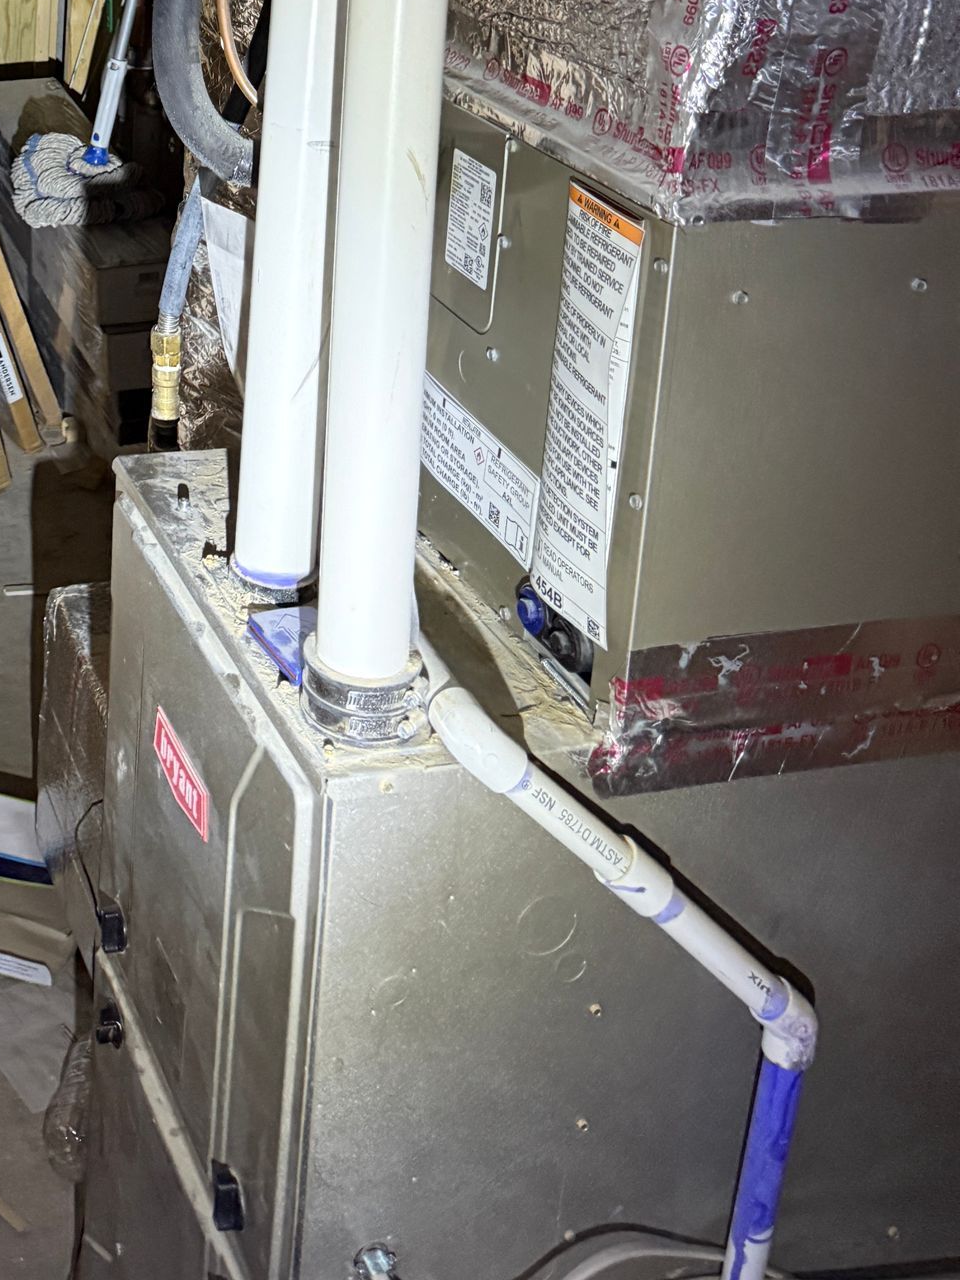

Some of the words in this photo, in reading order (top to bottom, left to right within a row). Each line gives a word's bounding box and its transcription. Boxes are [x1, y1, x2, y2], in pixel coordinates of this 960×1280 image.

[501, 70, 540, 101] Shurtape
[550, 96, 565, 111] AF
[565, 99, 584, 119] 099
[613, 121, 657, 159] Shurtape
[690, 155, 706, 170] AF
[579, 208, 590, 224] RISK
[590, 215, 597, 230] OF
[598, 221, 611, 240] FIRE
[583, 196, 611, 224] WARNING
[586, 243, 615, 273] REPAIRED
[590, 230, 633, 270] REFRIGERANT
[576, 250, 597, 277] TRAINED
[598, 268, 623, 296] SERVICE
[583, 272, 590, 286] DO
[591, 278, 603, 297] NOT
[577, 280, 613, 321] REFRIGERANT
[0, 359, 16, 396] ANDERSEN
[572, 366, 605, 407] REFRIGERANT
[437, 402, 474, 445] INSTALLATION
[565, 390, 584, 419] DEVICES
[585, 411, 603, 435] WHICH
[434, 423, 449, 447] ROOM
[450, 440, 465, 462] AREA
[571, 425, 600, 460] INSTALLED
[577, 417, 603, 449] SOURCES
[437, 451, 459, 482] CHARGE
[440, 443, 448, 459] OR
[582, 449, 602, 475] OTHER
[422, 446, 434, 470] TOTAL
[436, 462, 459, 494] CHARGE
[490, 452, 529, 499] REFRIGERANT
[572, 467, 586, 489] WITH
[587, 481, 599, 500] THE
[573, 455, 598, 486] DEVICES
[487, 462, 509, 492] SAFETY
[510, 484, 529, 512] GROUP
[585, 492, 598, 512] SEE
[546, 482, 572, 520] DETECTION
[573, 511, 598, 542] SYSTEM
[553, 520, 575, 549] EXCEPT
[570, 521, 587, 545] MUST
[588, 538, 597, 554] BE
[544, 541, 556, 563] READ
[542, 554, 563, 584] MANUAL
[160, 727, 198, 820] bryant
[531, 787, 556, 811] NSF
[559, 808, 592, 840] D1785
[590, 836, 623, 866] ASTM
